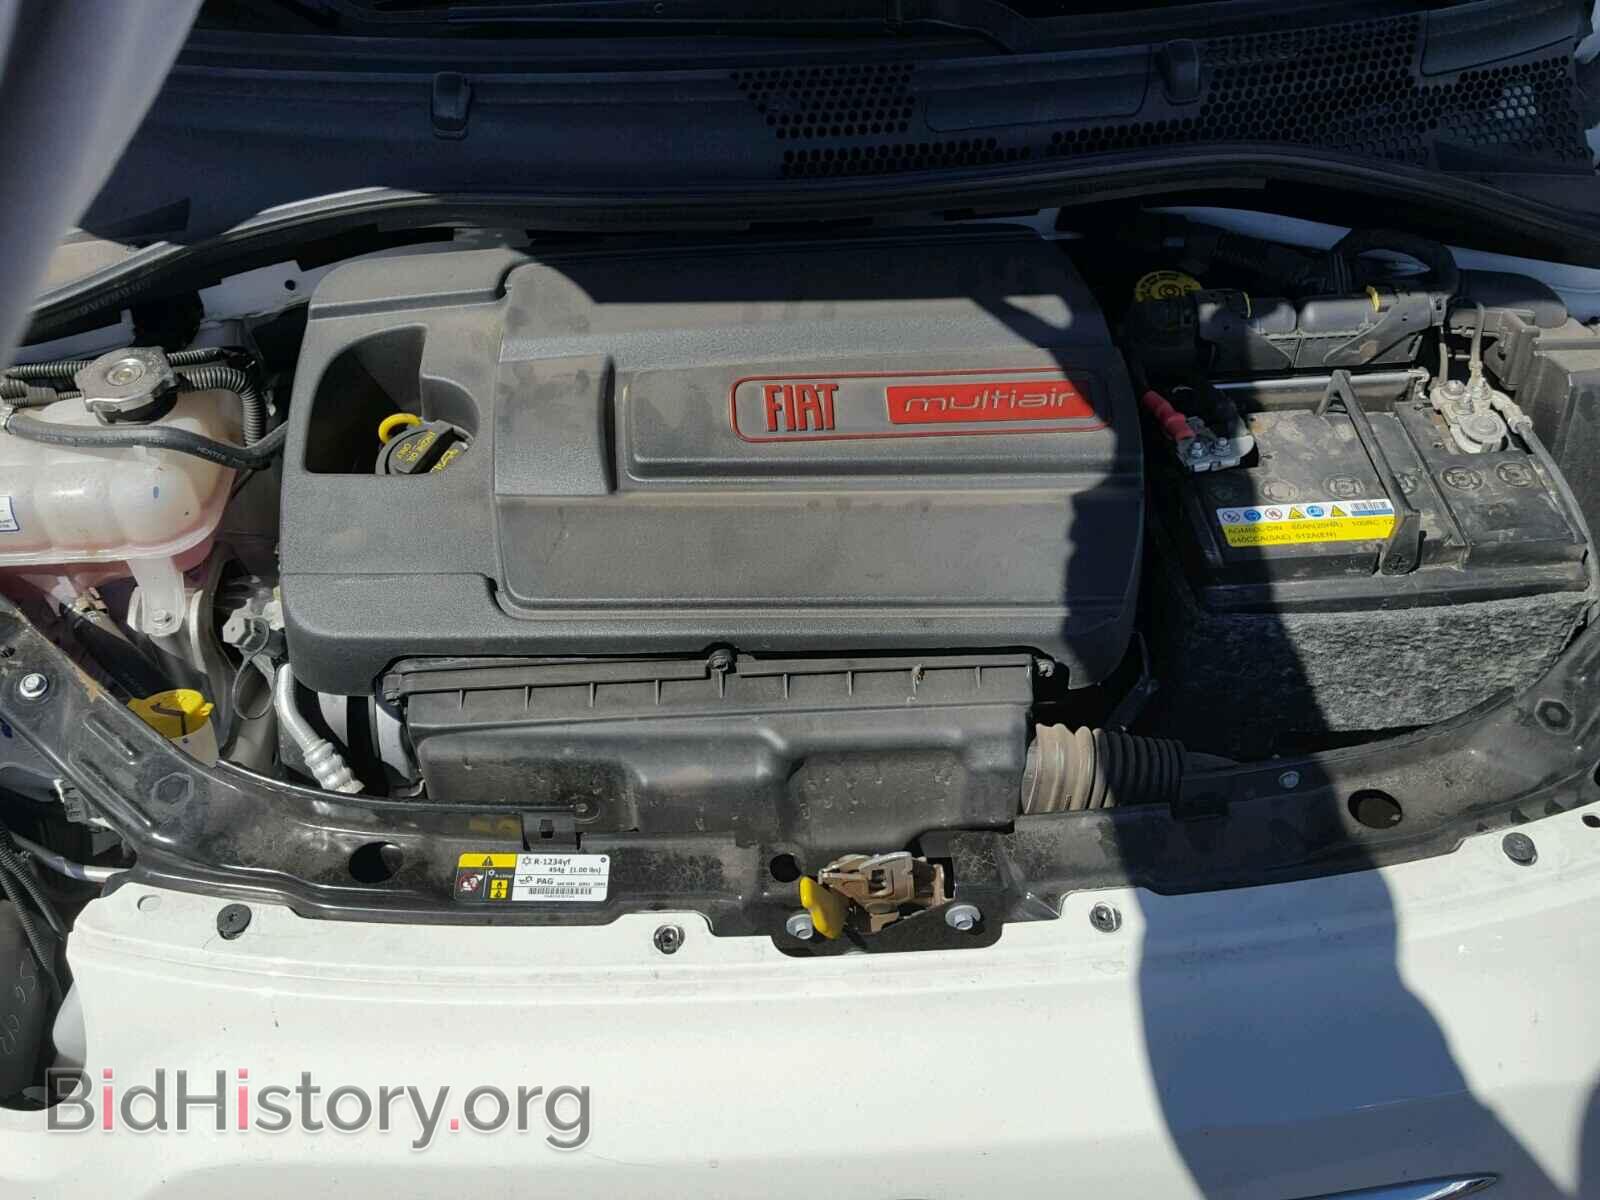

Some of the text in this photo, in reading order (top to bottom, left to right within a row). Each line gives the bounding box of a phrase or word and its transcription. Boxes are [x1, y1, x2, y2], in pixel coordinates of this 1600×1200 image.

[762, 383, 1076, 433] FIAT multiair
[533, 857, 571, 867] R-1234yf
[536, 877, 554, 886] PAG
